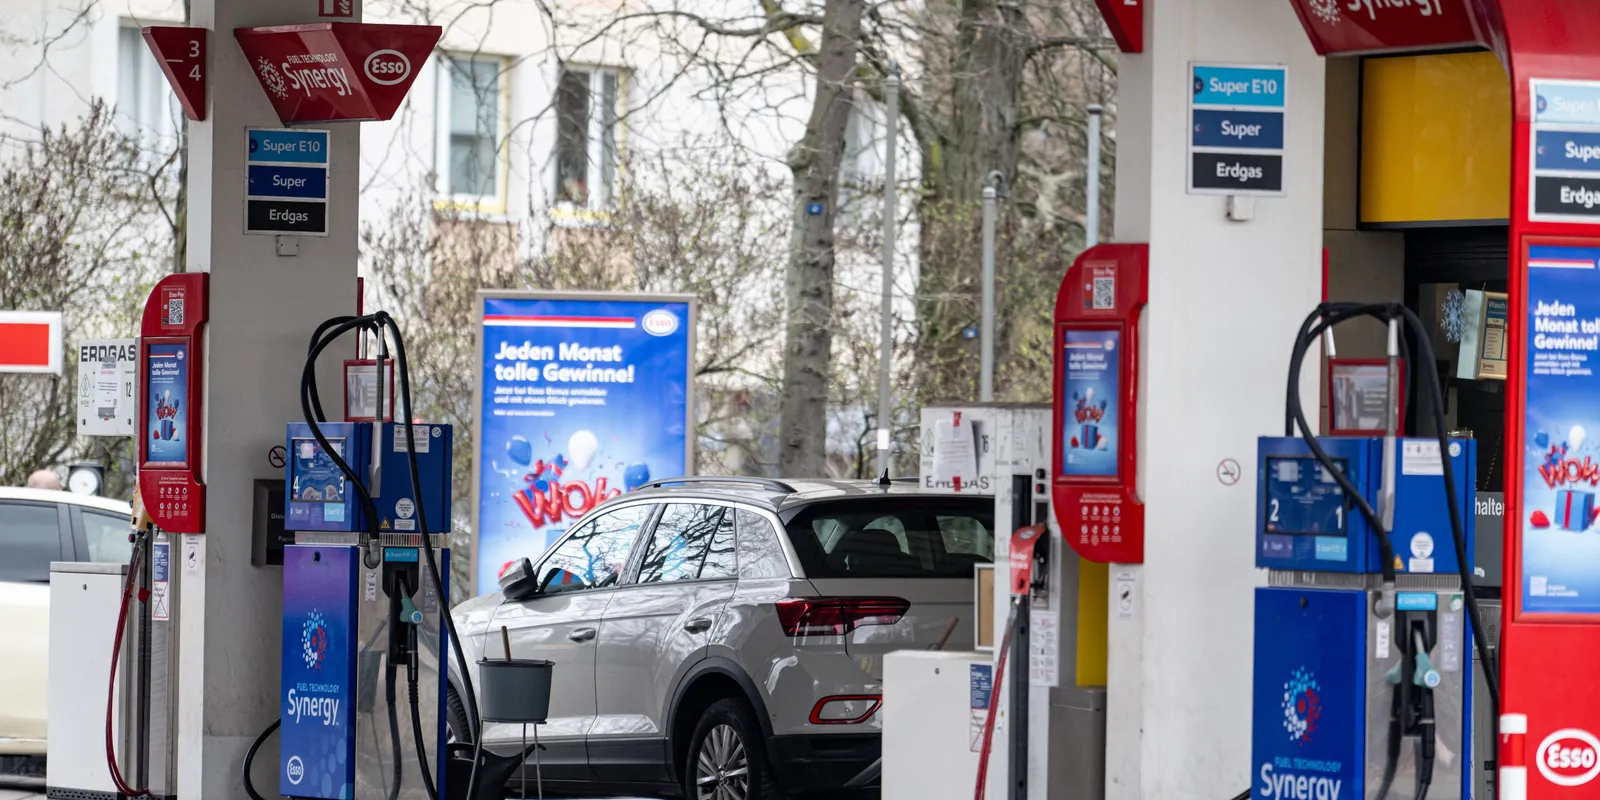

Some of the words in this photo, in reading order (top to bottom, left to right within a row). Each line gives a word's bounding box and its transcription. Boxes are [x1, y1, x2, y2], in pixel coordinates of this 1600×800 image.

[188, 40, 200, 58] 3
[286, 55, 302, 64] FUEL
[302, 53, 338, 64] TECHNOLOGY
[371, 58, 404, 74] Esso
[188, 64, 201, 81] 4
[281, 62, 352, 97] Synergy
[1209, 76, 1250, 97] Super
[1251, 78, 1278, 95] E10
[1553, 96, 1594, 115] Super
[1220, 119, 1262, 140] Super
[263, 139, 297, 155] Super
[299, 140, 320, 152] E10
[1216, 161, 1263, 182] Erdgas
[272, 174, 307, 190] Super
[269, 208, 309, 225] Erdgas
[1534, 299, 1576, 317] Jeden
[1534, 316, 1579, 334] Monat
[1534, 333, 1598, 351] Gewinne!
[80, 345, 136, 362] ERDGAS
[494, 340, 554, 361] Jeden
[558, 342, 623, 363] Monat
[494, 362, 540, 383] tolle
[542, 363, 636, 384] Gewinne!
[125, 382, 132, 397] 12
[293, 475, 300, 494] 4
[338, 475, 345, 494] 3
[1269, 498, 1280, 522] 2
[1335, 505, 1343, 529] 1
[296, 682, 308, 692] FUEL
[309, 683, 340, 693] TECHNOLOGY
[287, 688, 340, 726] Synergy
[1547, 742, 1596, 769] Esso
[289, 762, 302, 776] Esso
